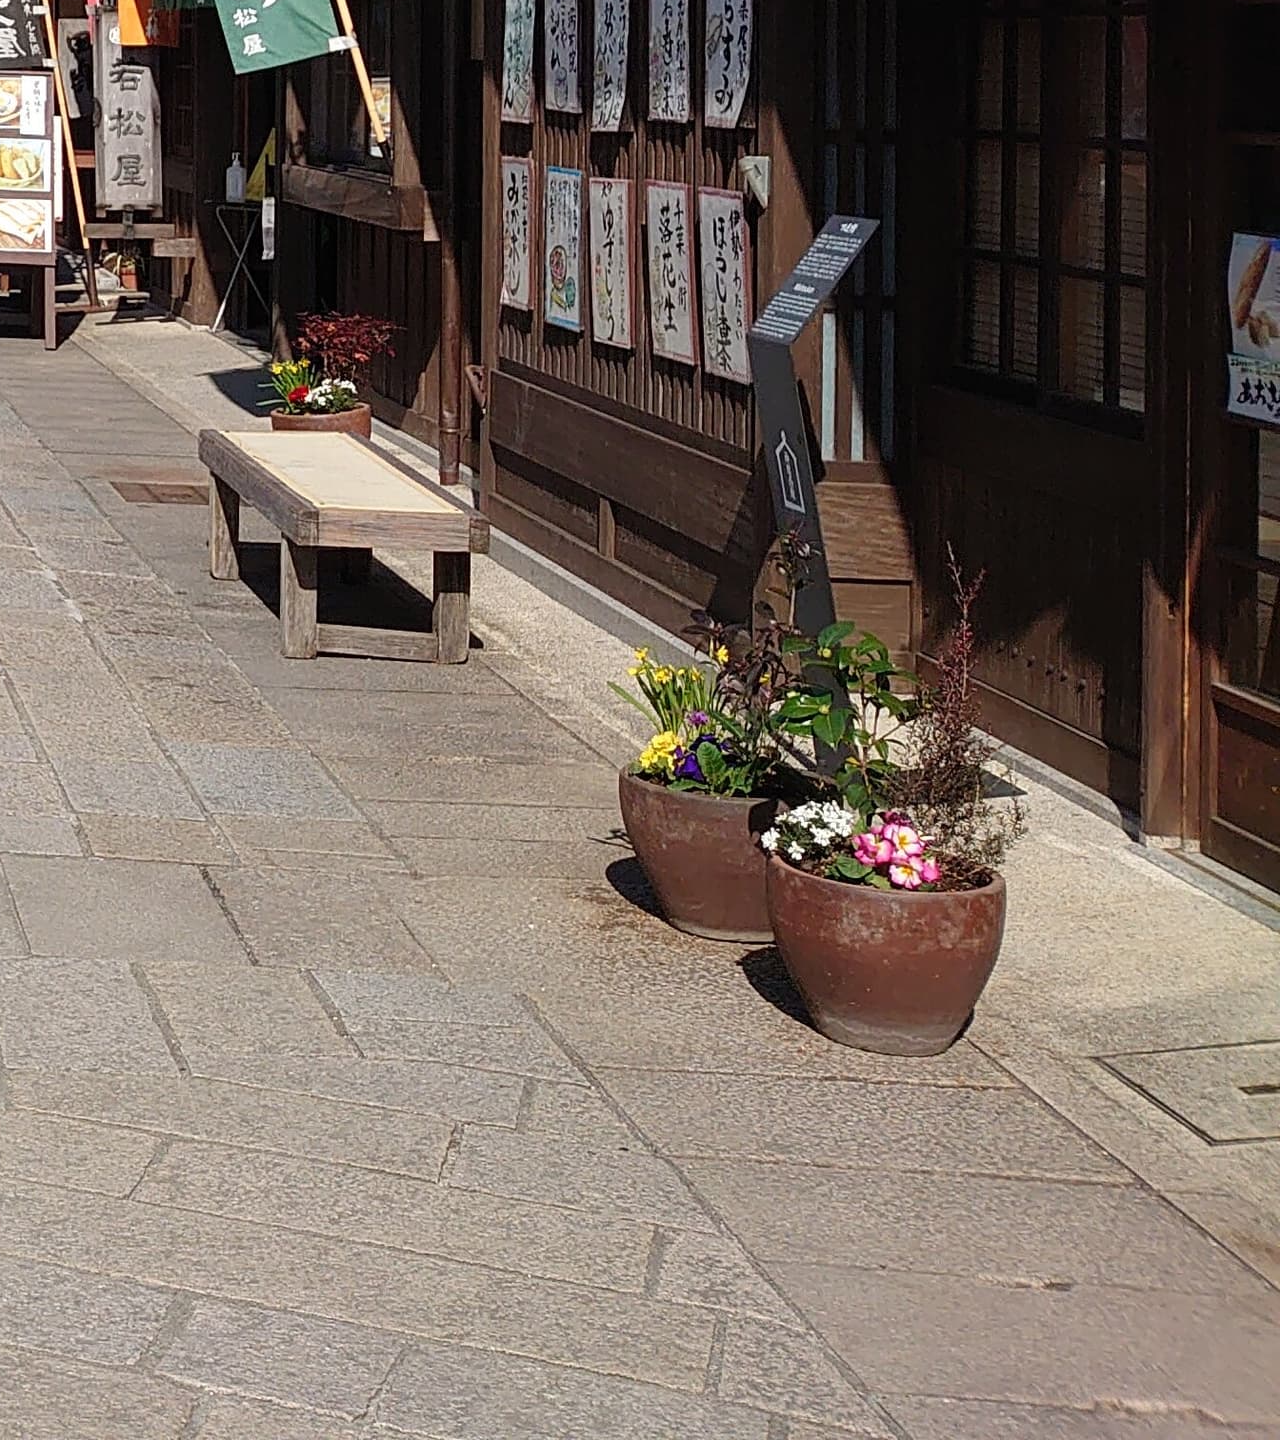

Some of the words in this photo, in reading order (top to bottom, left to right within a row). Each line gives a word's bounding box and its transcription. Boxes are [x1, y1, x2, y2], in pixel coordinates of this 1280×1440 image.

[109, 57, 147, 187] 若松屋
[658, 200, 678, 333] 落花生
[713, 216, 733, 373] ほうじ番茶
